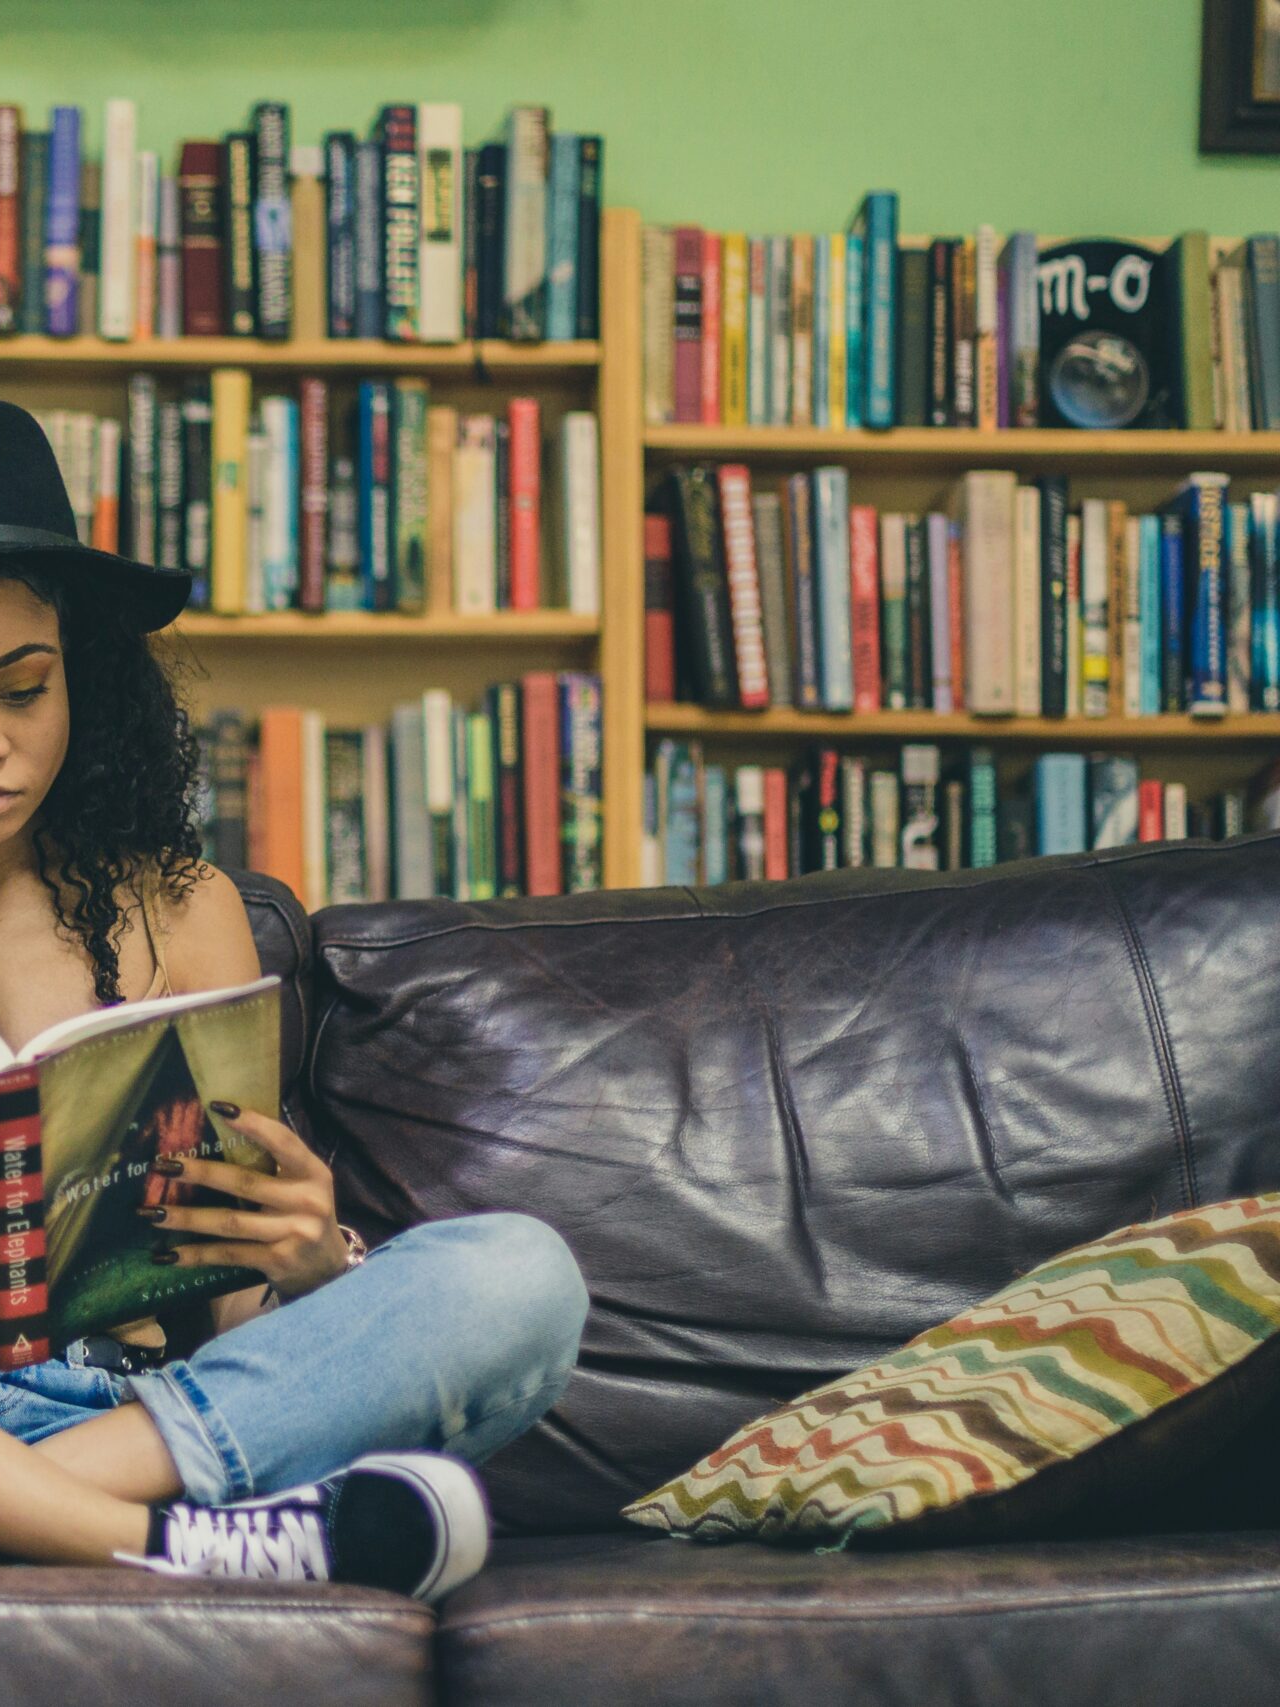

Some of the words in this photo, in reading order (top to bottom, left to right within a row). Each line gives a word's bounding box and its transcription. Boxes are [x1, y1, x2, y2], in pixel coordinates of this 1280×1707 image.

[3, 1134, 27, 1186] Water
[65, 1169, 120, 1203] Water
[127, 1160, 150, 1179] for
[5, 1191, 29, 1216] for
[3, 1219, 32, 1306] Elephants
[141, 1283, 187, 1303] SARA
